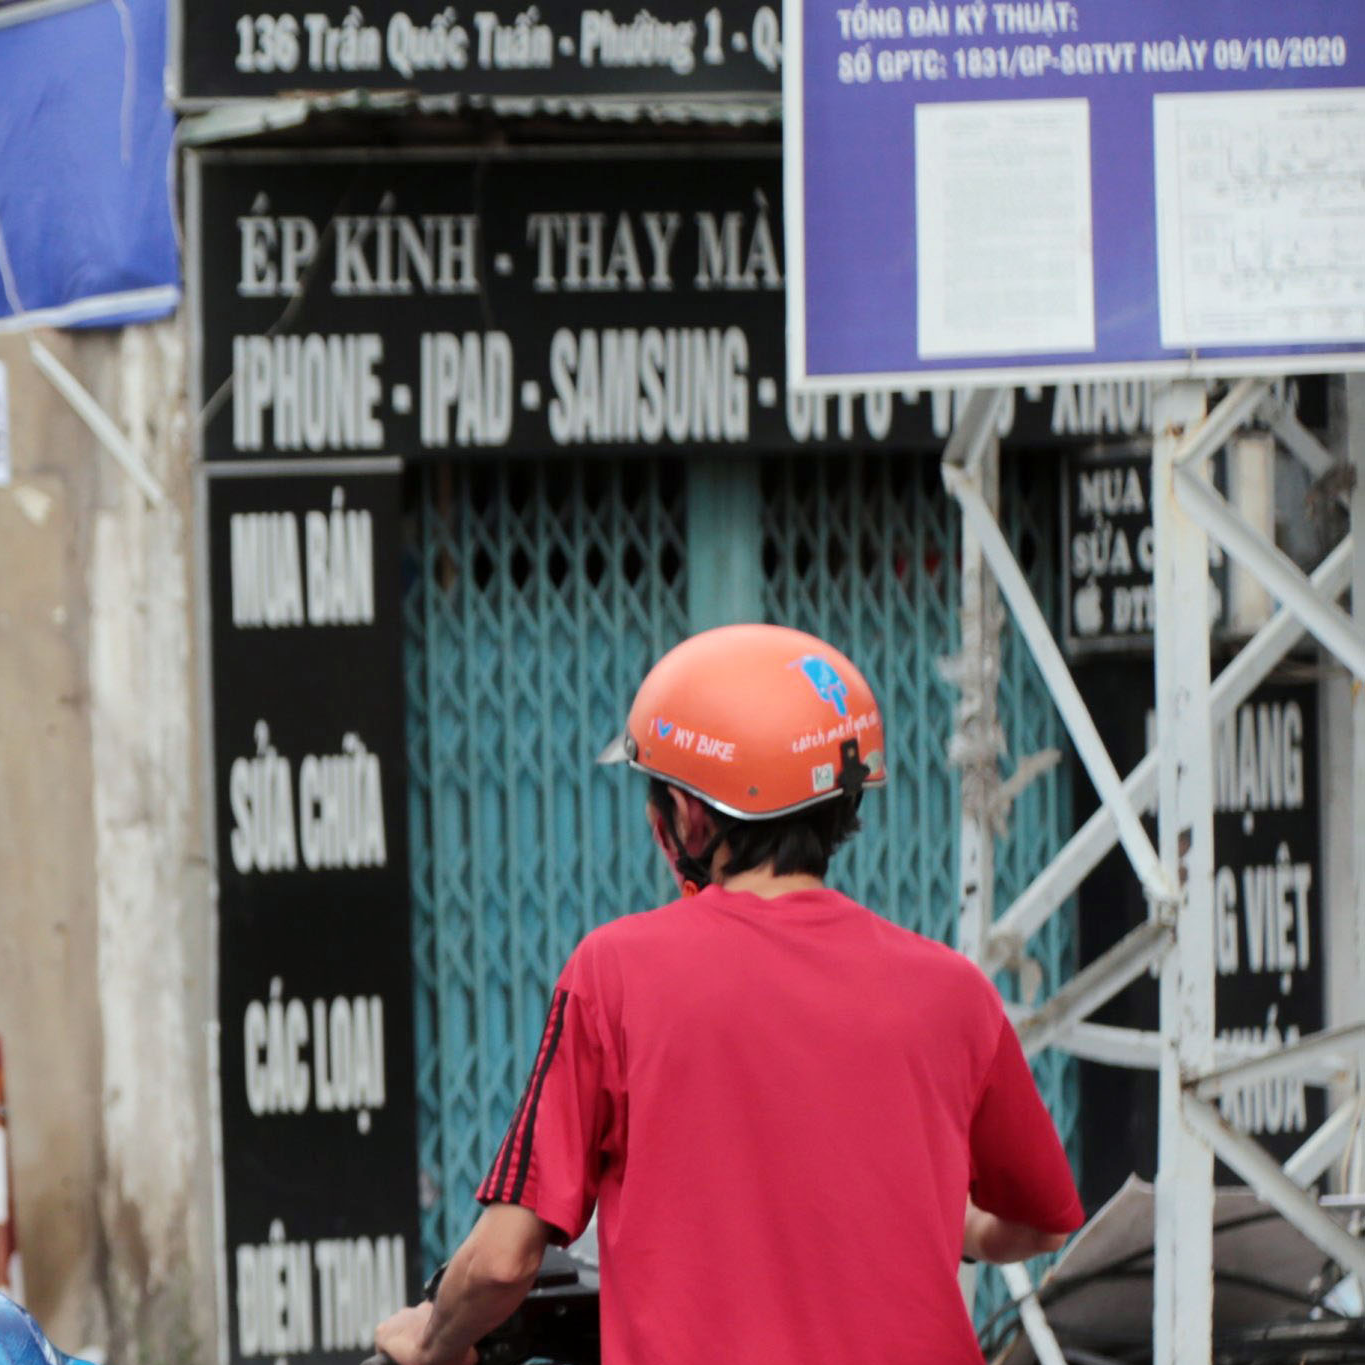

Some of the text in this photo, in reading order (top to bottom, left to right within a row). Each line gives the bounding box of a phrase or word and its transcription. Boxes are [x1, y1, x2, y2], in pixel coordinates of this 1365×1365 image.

[234, 13, 300, 73] 136
[386, 6, 469, 80] Quốc
[703, 6, 725, 65] 1
[1142, 35, 1208, 73] NGÀY
[1213, 35, 1347, 71] 09/10/2020
[331, 190, 479, 297] KÍNH
[526, 210, 681, 291] THAY
[695, 186, 785, 292] MÀ
[232, 331, 385, 452] IPHONE
[420, 330, 513, 448] IPAD
[549, 327, 749, 445] SAMSUNG
[1077, 465, 1145, 518] MUA
[230, 485, 375, 629] MUA BÁN
[229, 718, 387, 876] SỬA CHỮA
[673, 727, 695, 751] MY
[696, 734, 736, 762] BIKE
[1242, 840, 1312, 996] VIỆT
[243, 974, 387, 1136] CÁC LOẠI
